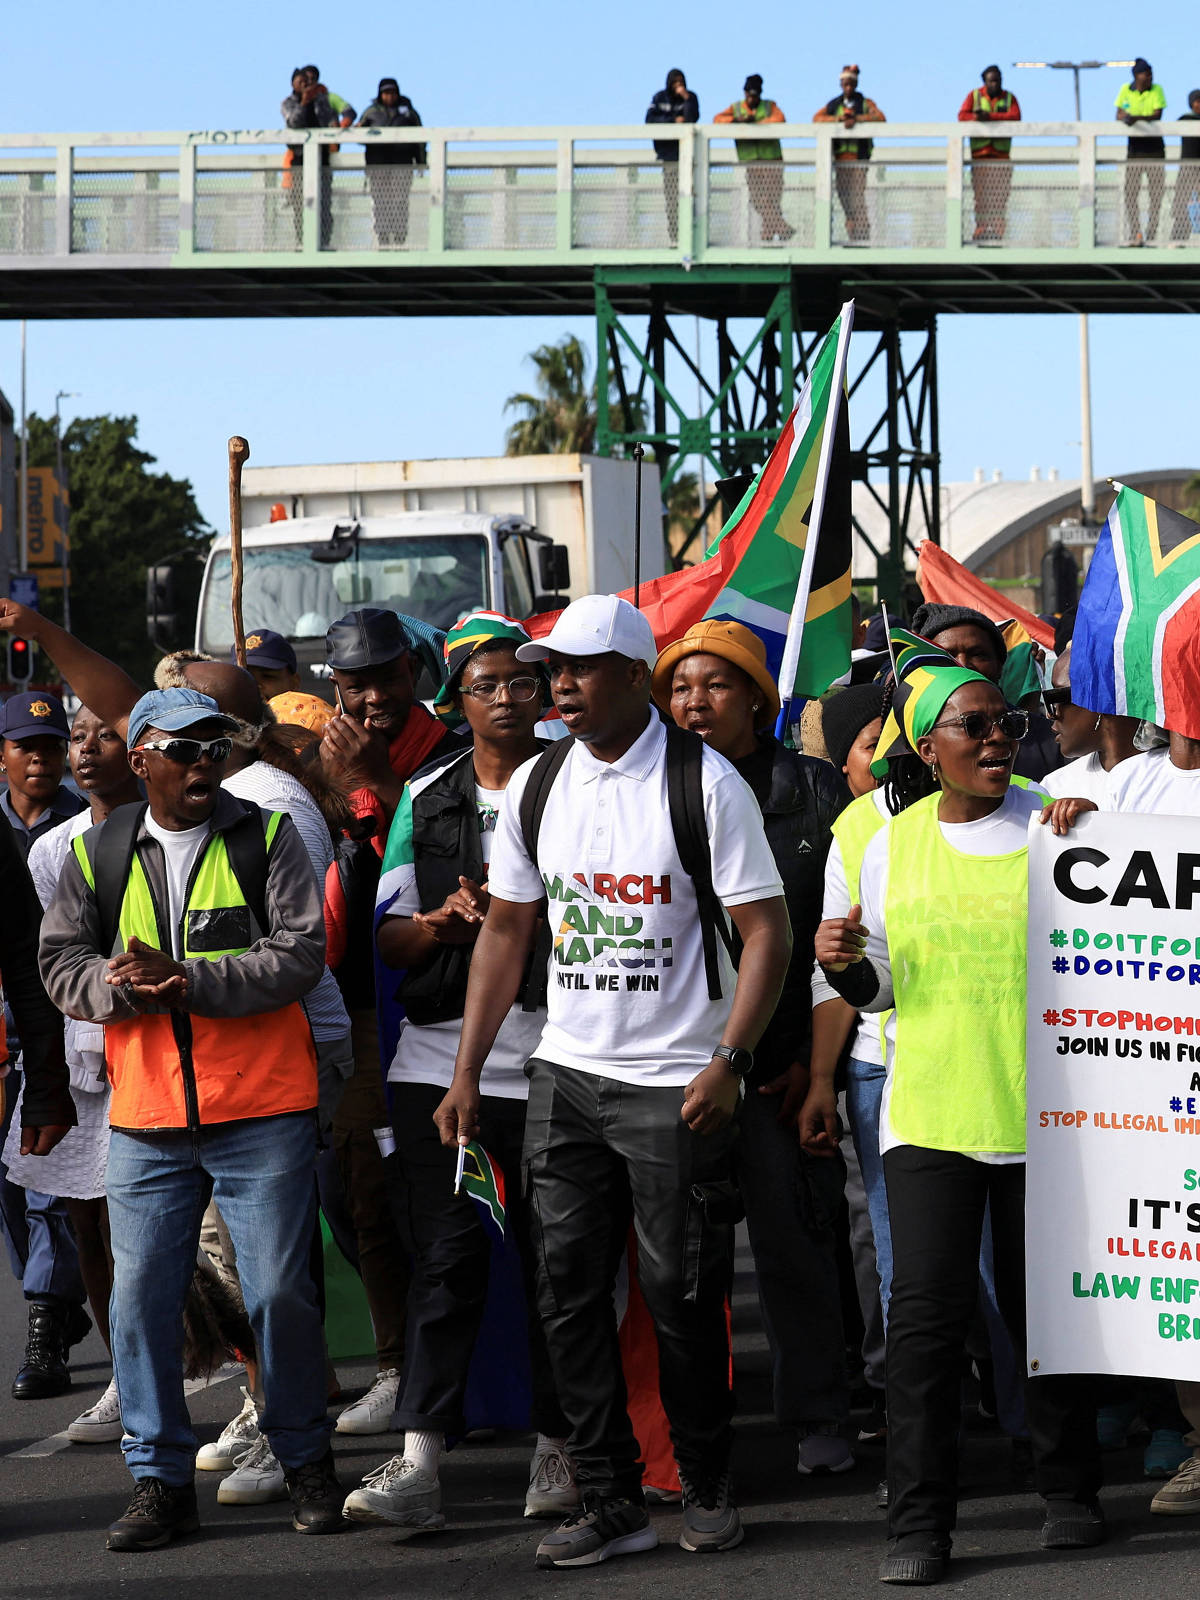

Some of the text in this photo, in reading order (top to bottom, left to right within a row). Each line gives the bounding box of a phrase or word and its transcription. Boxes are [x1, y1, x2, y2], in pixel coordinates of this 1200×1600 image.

[29, 477, 45, 554] metro
[543, 873, 671, 904] MARCH
[559, 905, 643, 936] AND
[557, 972, 659, 991] NTIL WE WIN
[1056, 1036, 1109, 1057] JOIN
[1115, 1038, 1143, 1059] US
[1149, 1041, 1171, 1061] IN
[1039, 1110, 1089, 1129] STOP
[1093, 1111, 1169, 1133] ILLEGAL
[1072, 1271, 1141, 1300] LAW
